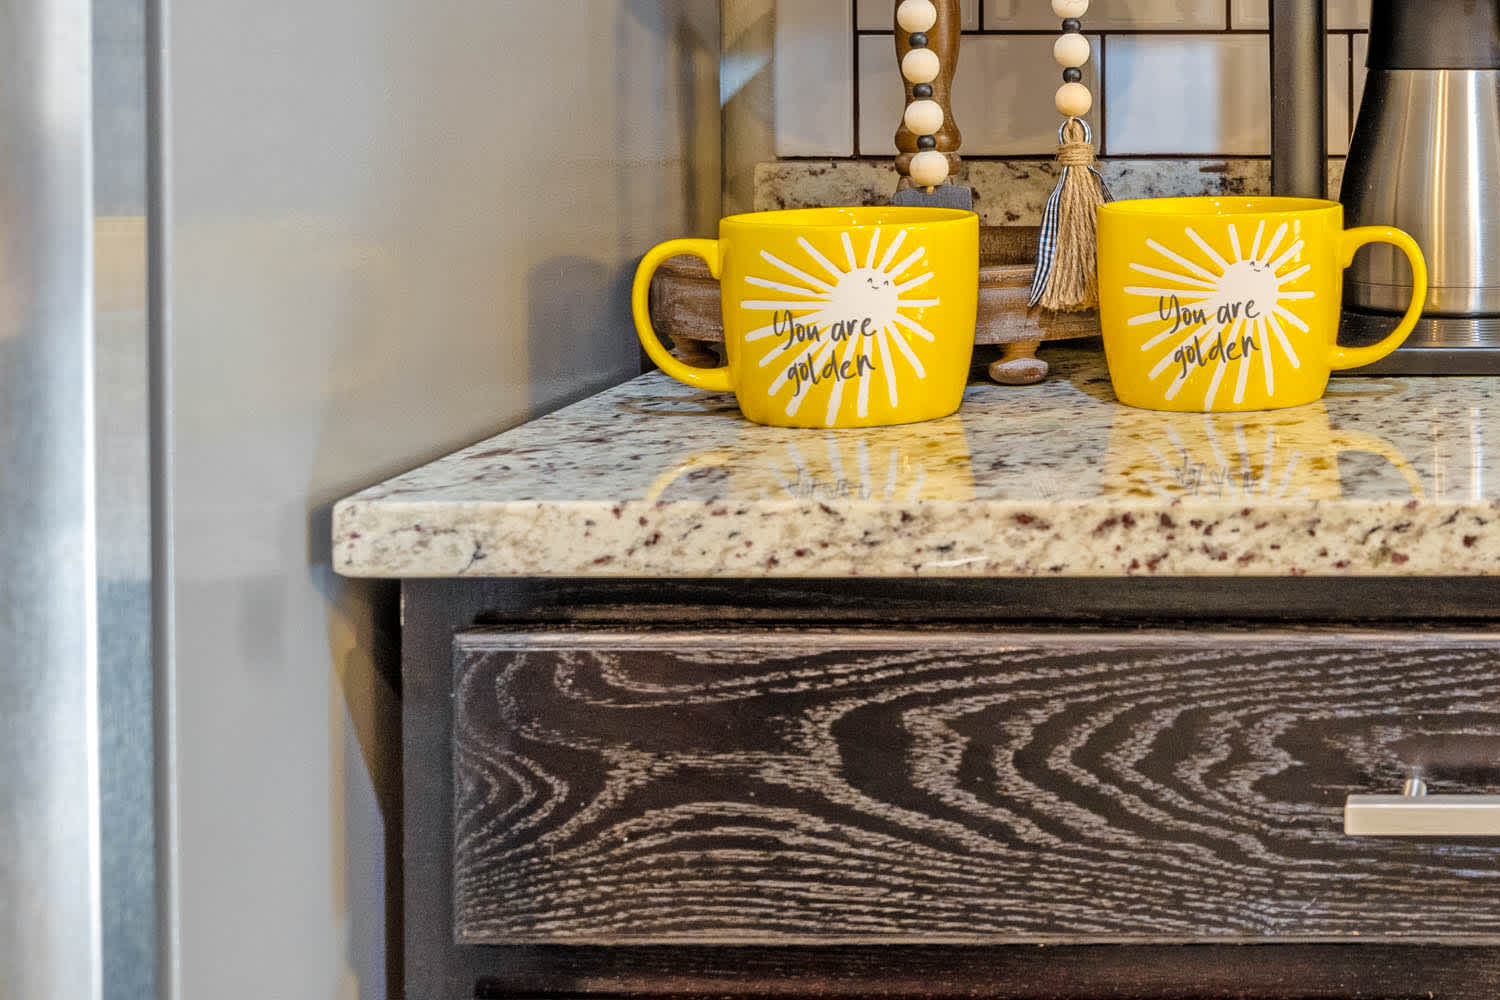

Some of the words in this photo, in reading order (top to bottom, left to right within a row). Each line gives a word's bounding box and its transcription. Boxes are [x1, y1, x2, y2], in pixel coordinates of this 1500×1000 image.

[773, 310, 820, 350] You
[831, 317, 877, 342] are
[1159, 294, 1207, 334] You
[1217, 299, 1260, 324] are
[787, 350, 876, 397] golden
[1174, 332, 1259, 379] golden
